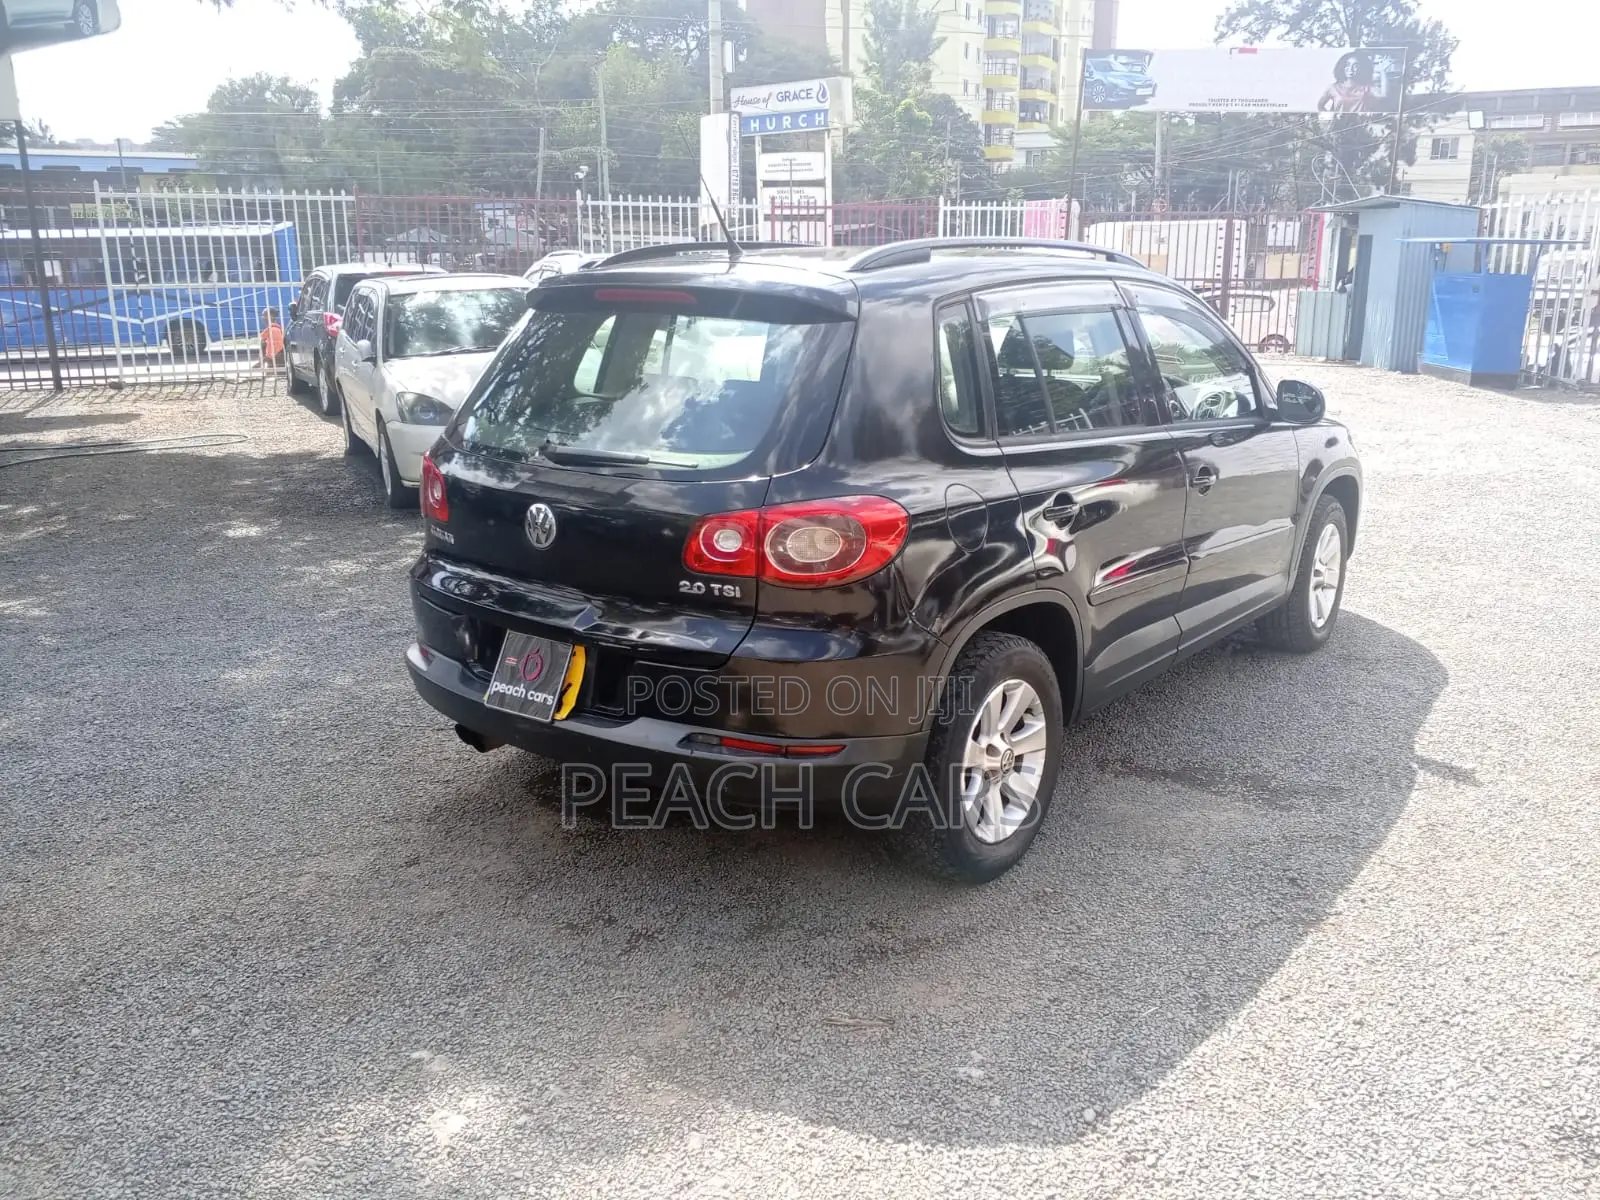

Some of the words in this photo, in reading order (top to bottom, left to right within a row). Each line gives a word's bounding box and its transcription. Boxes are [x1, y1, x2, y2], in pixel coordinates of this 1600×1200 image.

[733, 96, 761, 109] House
[762, 92, 773, 109] of
[776, 88, 814, 103] GRACE
[750, 112, 825, 133] HURCH
[709, 583, 741, 599] TSI
[491, 680, 526, 698] peach
[527, 688, 554, 706] cars
